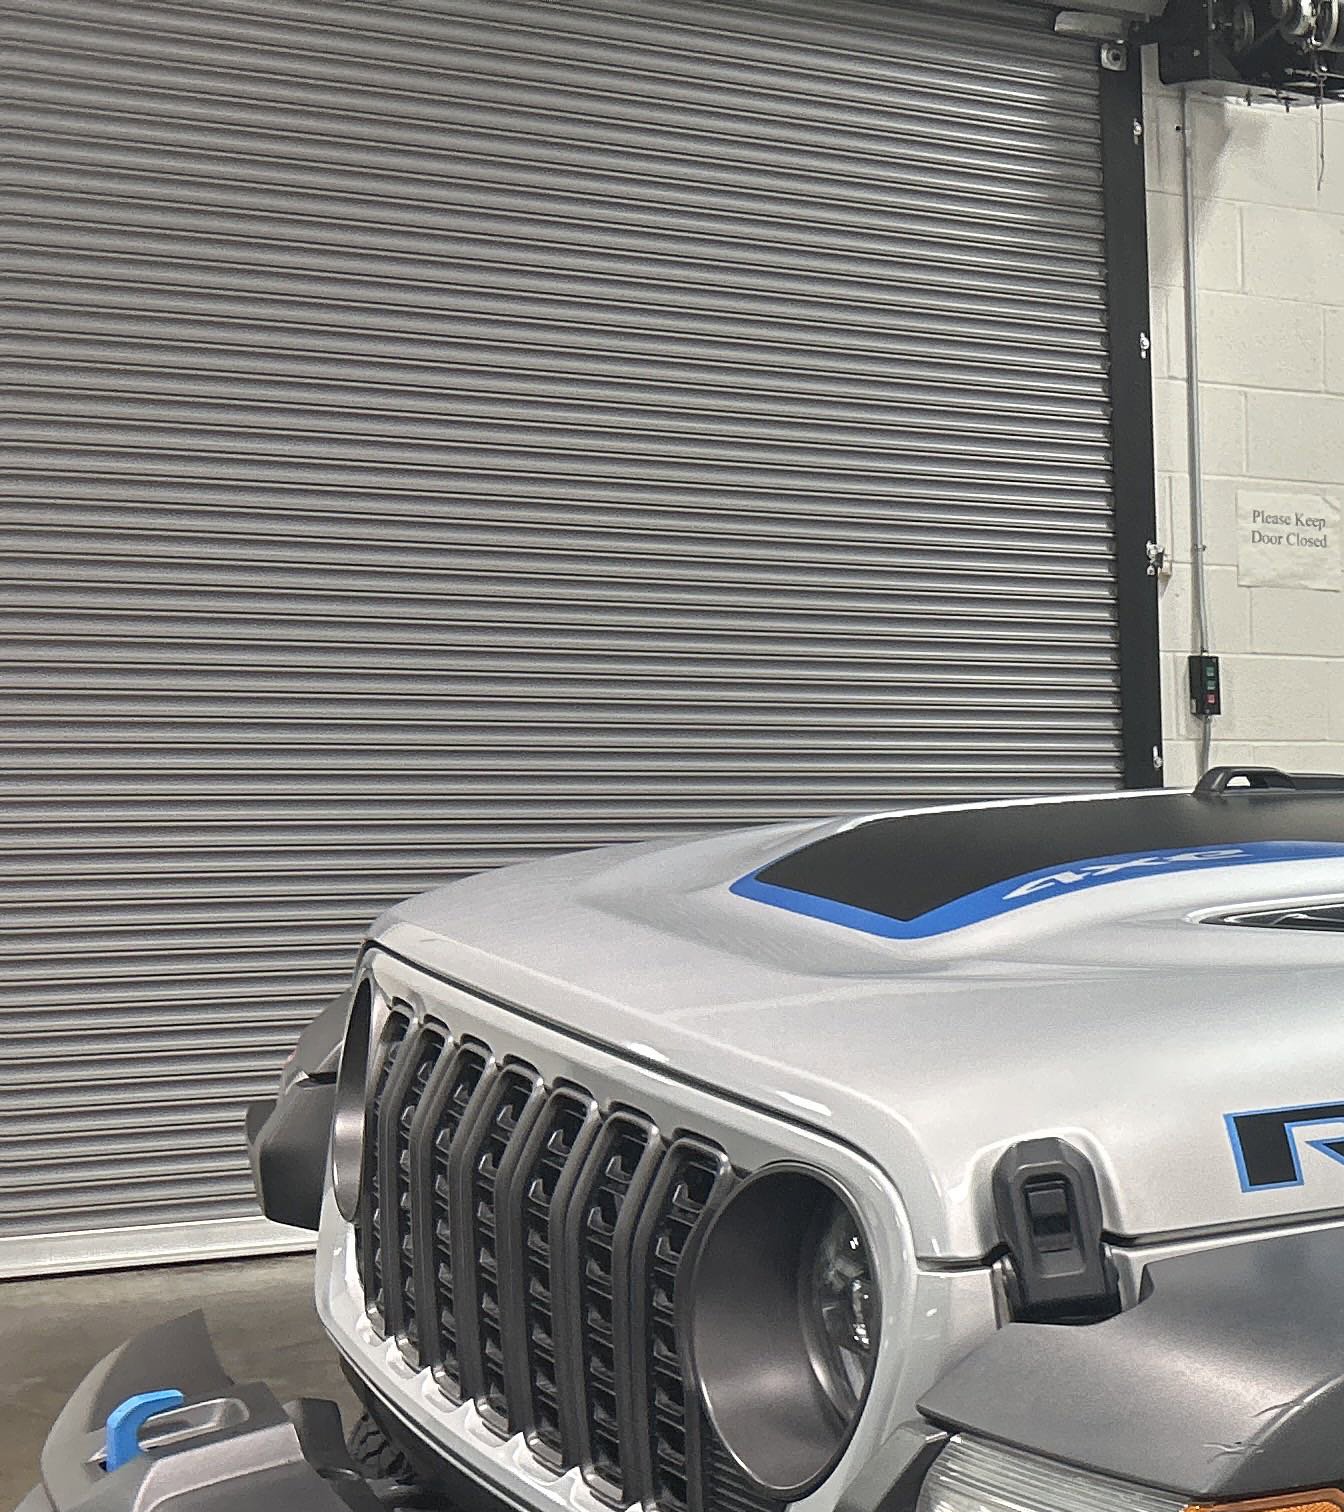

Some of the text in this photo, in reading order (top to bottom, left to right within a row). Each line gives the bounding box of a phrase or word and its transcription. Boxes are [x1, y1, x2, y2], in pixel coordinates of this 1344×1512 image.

[1252, 509, 1326, 531] Please Keep
[1251, 530, 1327, 548] Door Closed
